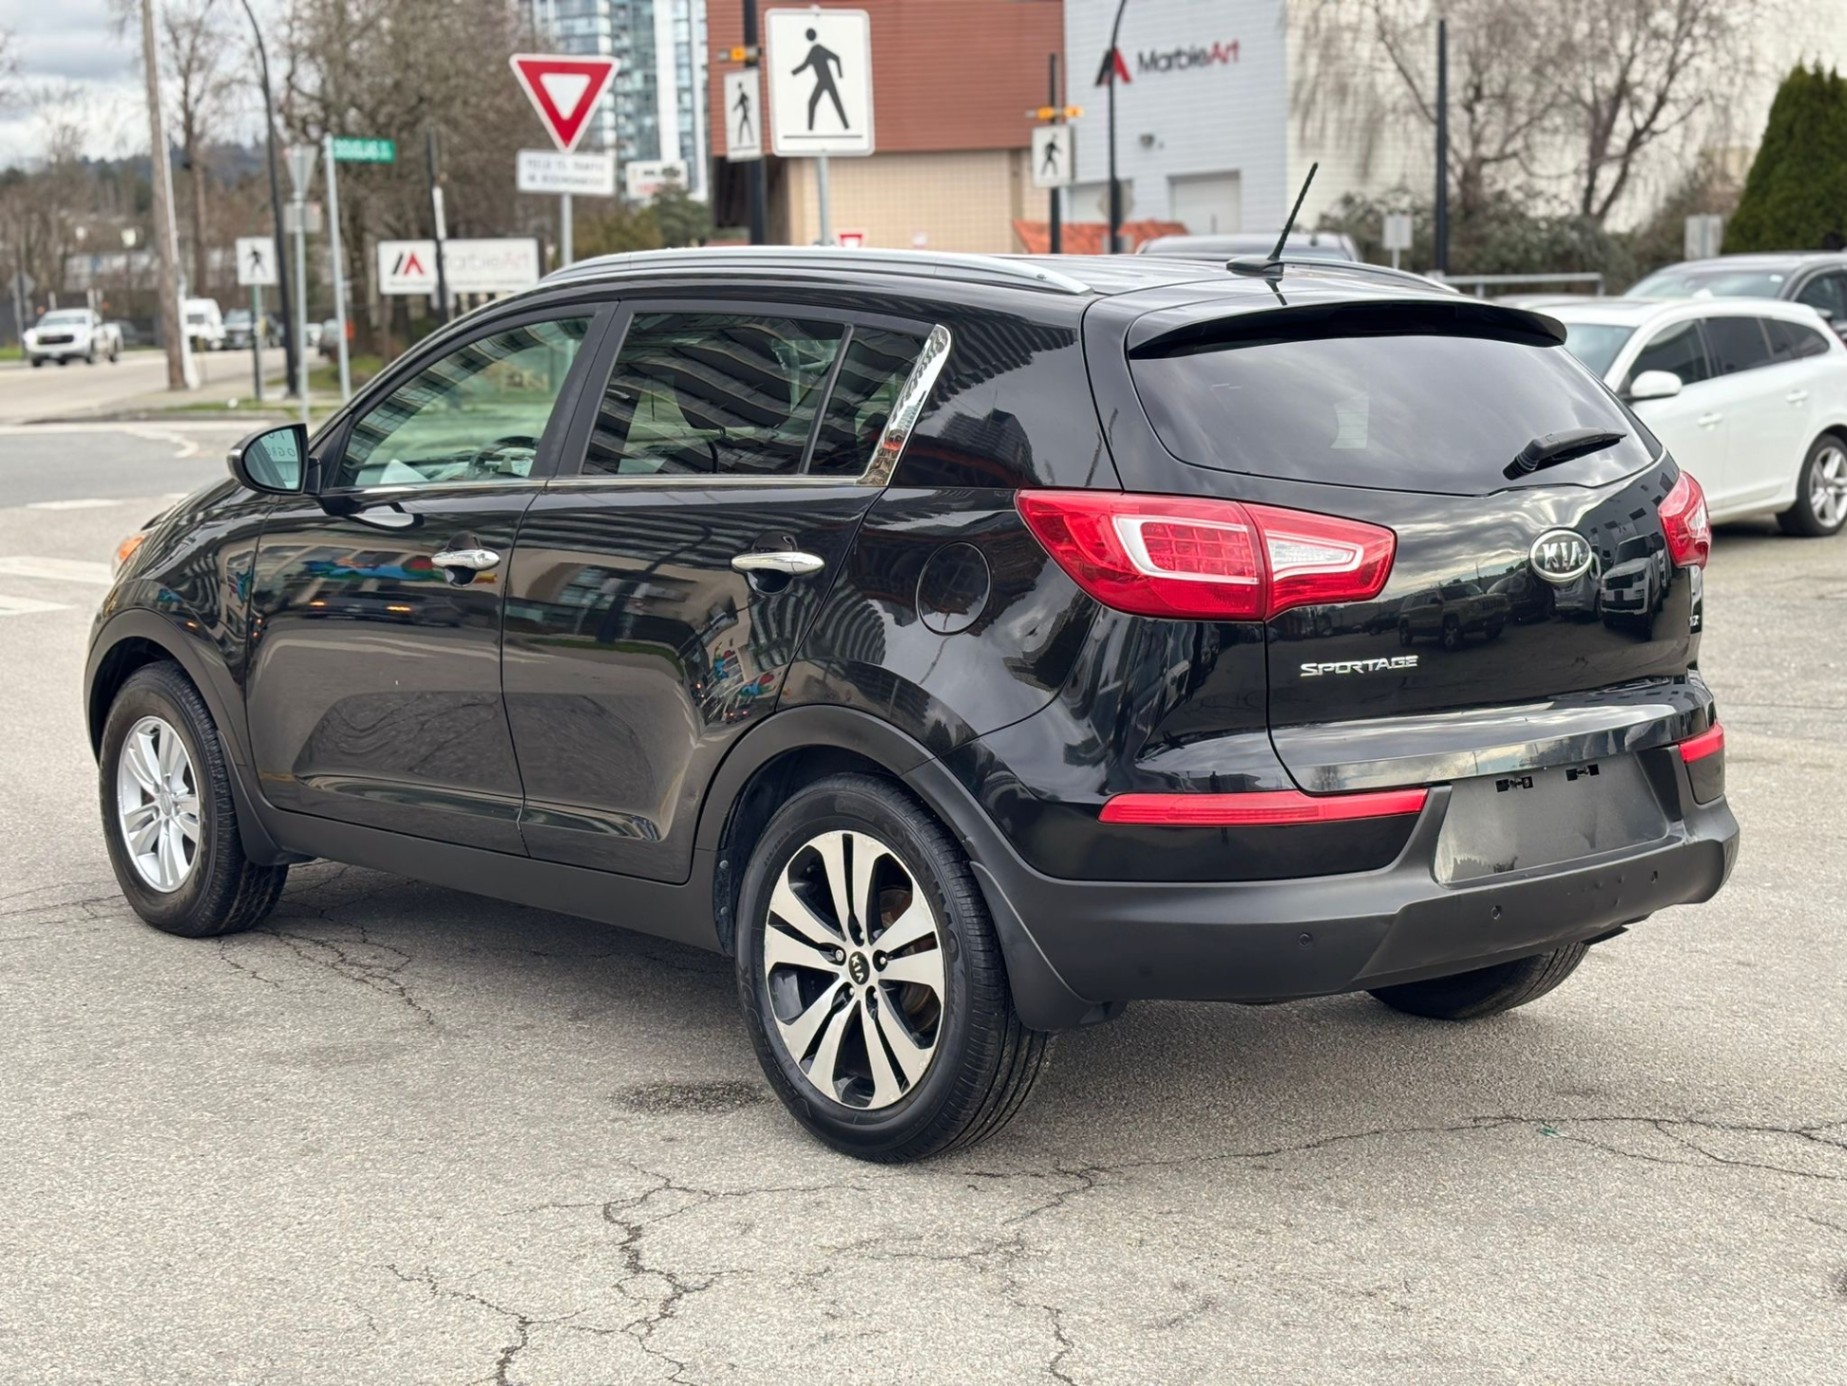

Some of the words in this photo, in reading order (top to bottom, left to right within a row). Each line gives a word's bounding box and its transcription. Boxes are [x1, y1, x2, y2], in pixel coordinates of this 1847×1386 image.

[1137, 39, 1240, 74] MarbleArt
[1541, 540, 1584, 570] KIA
[1300, 654, 1419, 678] SPORTAGE
[851, 954, 865, 983] KIA
